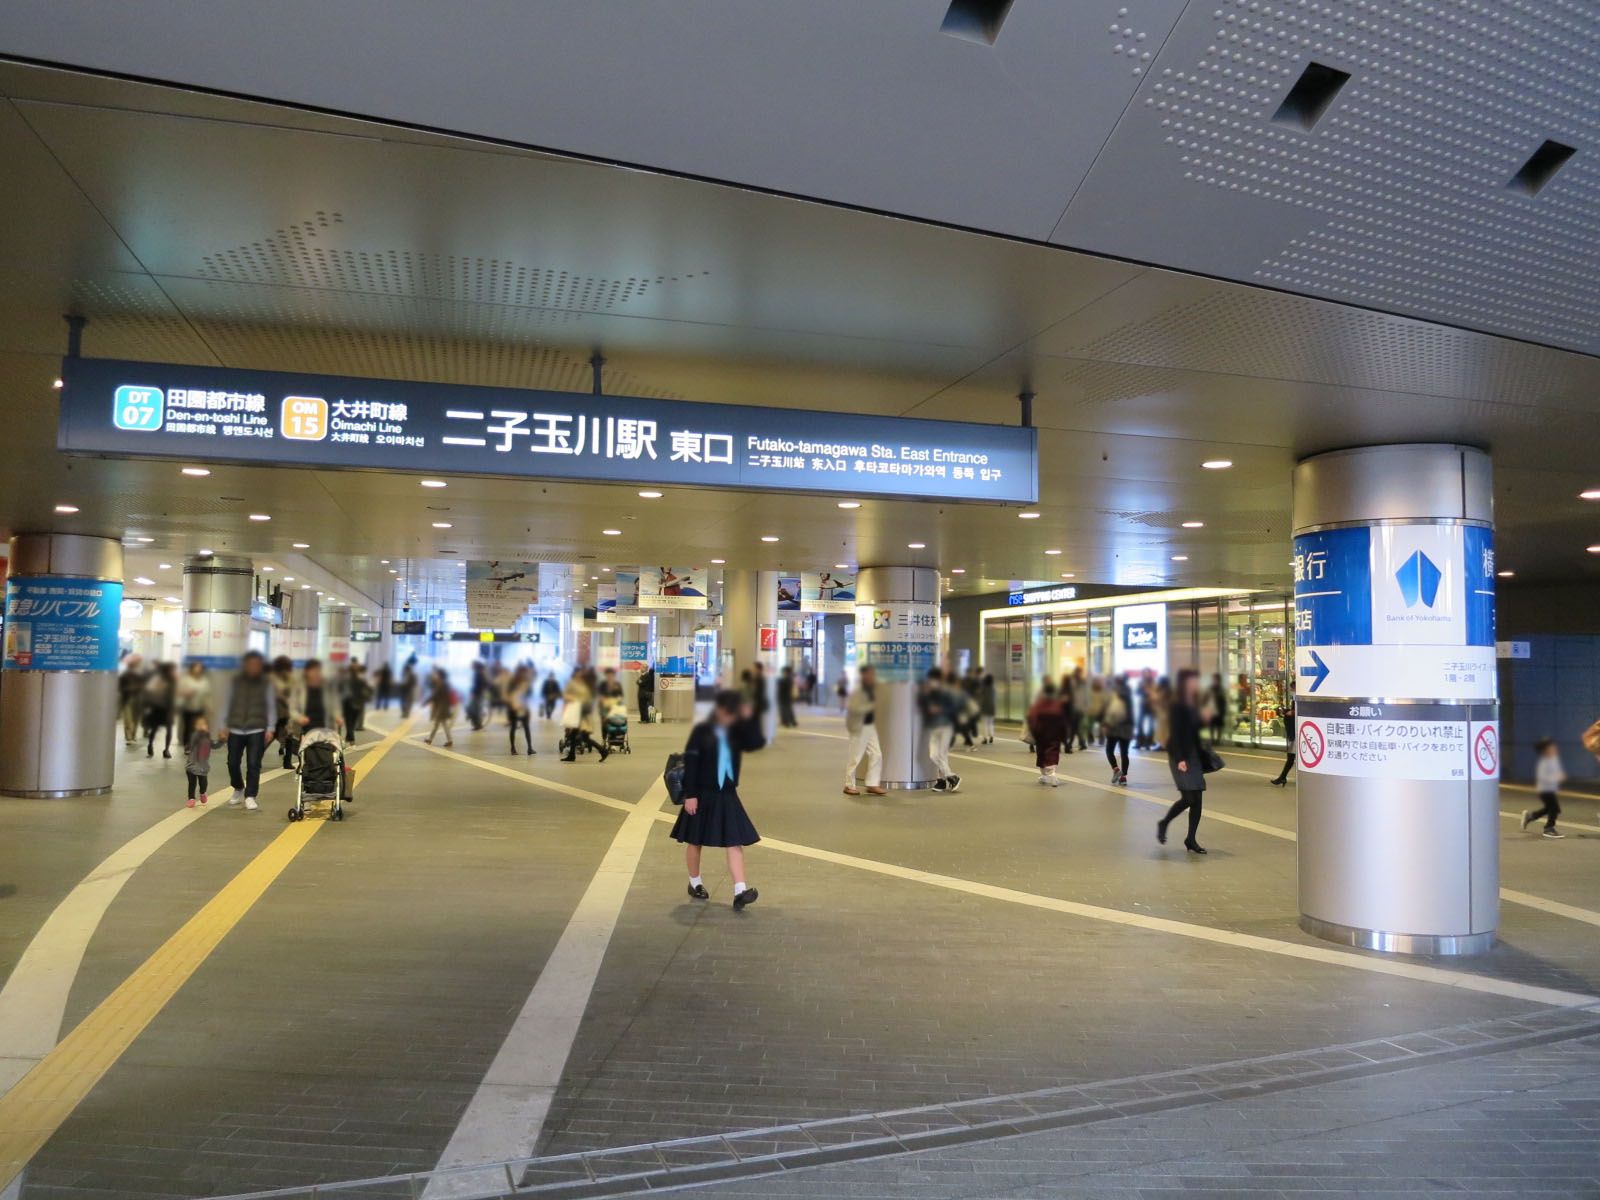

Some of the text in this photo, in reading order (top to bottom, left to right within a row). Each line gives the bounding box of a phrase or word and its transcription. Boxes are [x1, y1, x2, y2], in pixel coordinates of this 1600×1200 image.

[128, 390, 151, 404] DT
[167, 389, 266, 413] 田園都市線
[123, 406, 154, 425] 07
[292, 402, 318, 414] OM
[331, 399, 408, 421] 大井町線
[166, 409, 268, 426] Den-en-toshi Line
[292, 416, 319, 435] 15
[331, 417, 402, 433] Ōimachi Line
[375, 434, 425, 447] 오이마치선
[442, 410, 733, 464] 二子玉川駅 東口
[748, 436, 988, 464] Futako-tamagawa Sta. East Entrance
[748, 455, 805, 469] 二子玉川站
[811, 458, 846, 471] 东入口
[854, 459, 946, 477] 후타코타마가와역
[980, 468, 1002, 481] 입구
[1386, 614, 1452, 622] Bank of Yokohama
[1349, 706, 1382, 717] お願い
[1326, 722, 1464, 739] 自転車・バイクのりいれ禁止
[1327, 739, 1464, 752] 駅構内では自転車・バイクをおりて
[1327, 750, 1387, 762] お通りください
